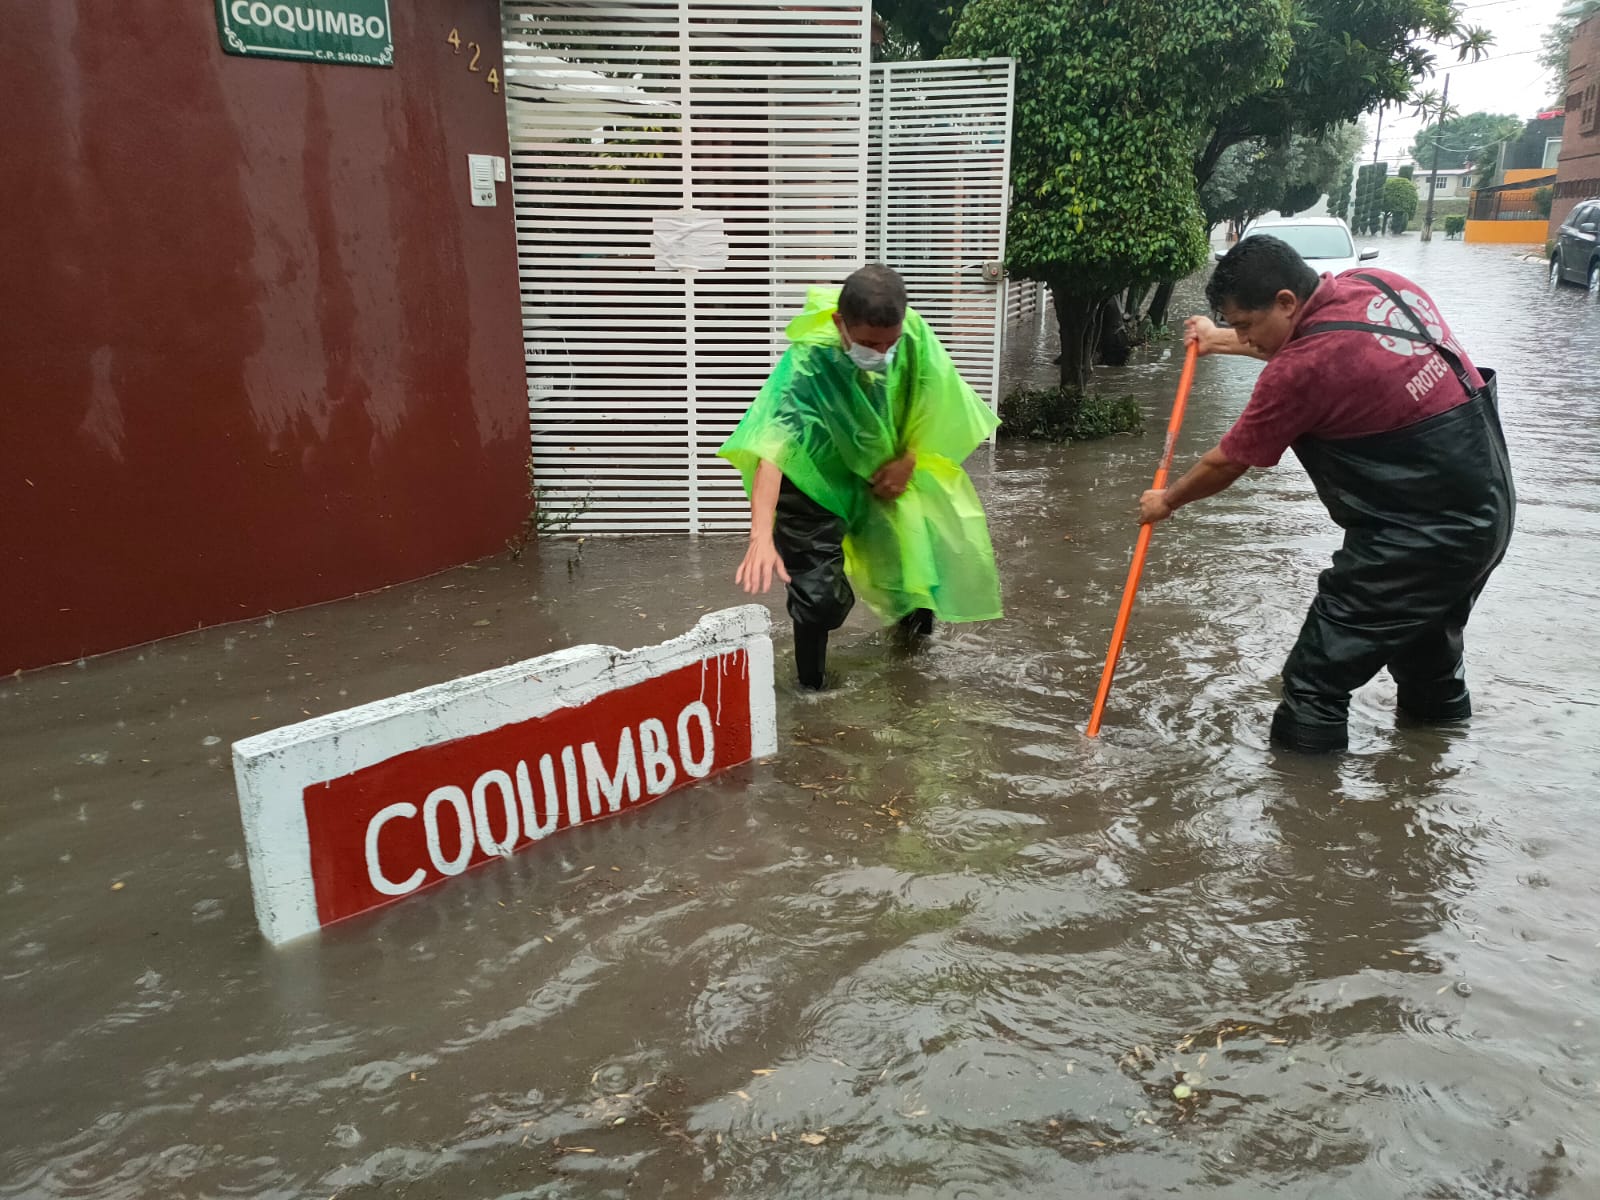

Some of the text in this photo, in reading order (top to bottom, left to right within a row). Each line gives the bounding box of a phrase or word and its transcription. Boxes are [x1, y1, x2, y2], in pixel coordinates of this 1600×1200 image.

[231, 0, 385, 39] COQUIMBO
[315, 49, 371, 63] C.P. 54020
[447, 28, 499, 93] 424
[1405, 353, 1449, 401] PROTEC
[364, 701, 715, 896] COQUIMBO
